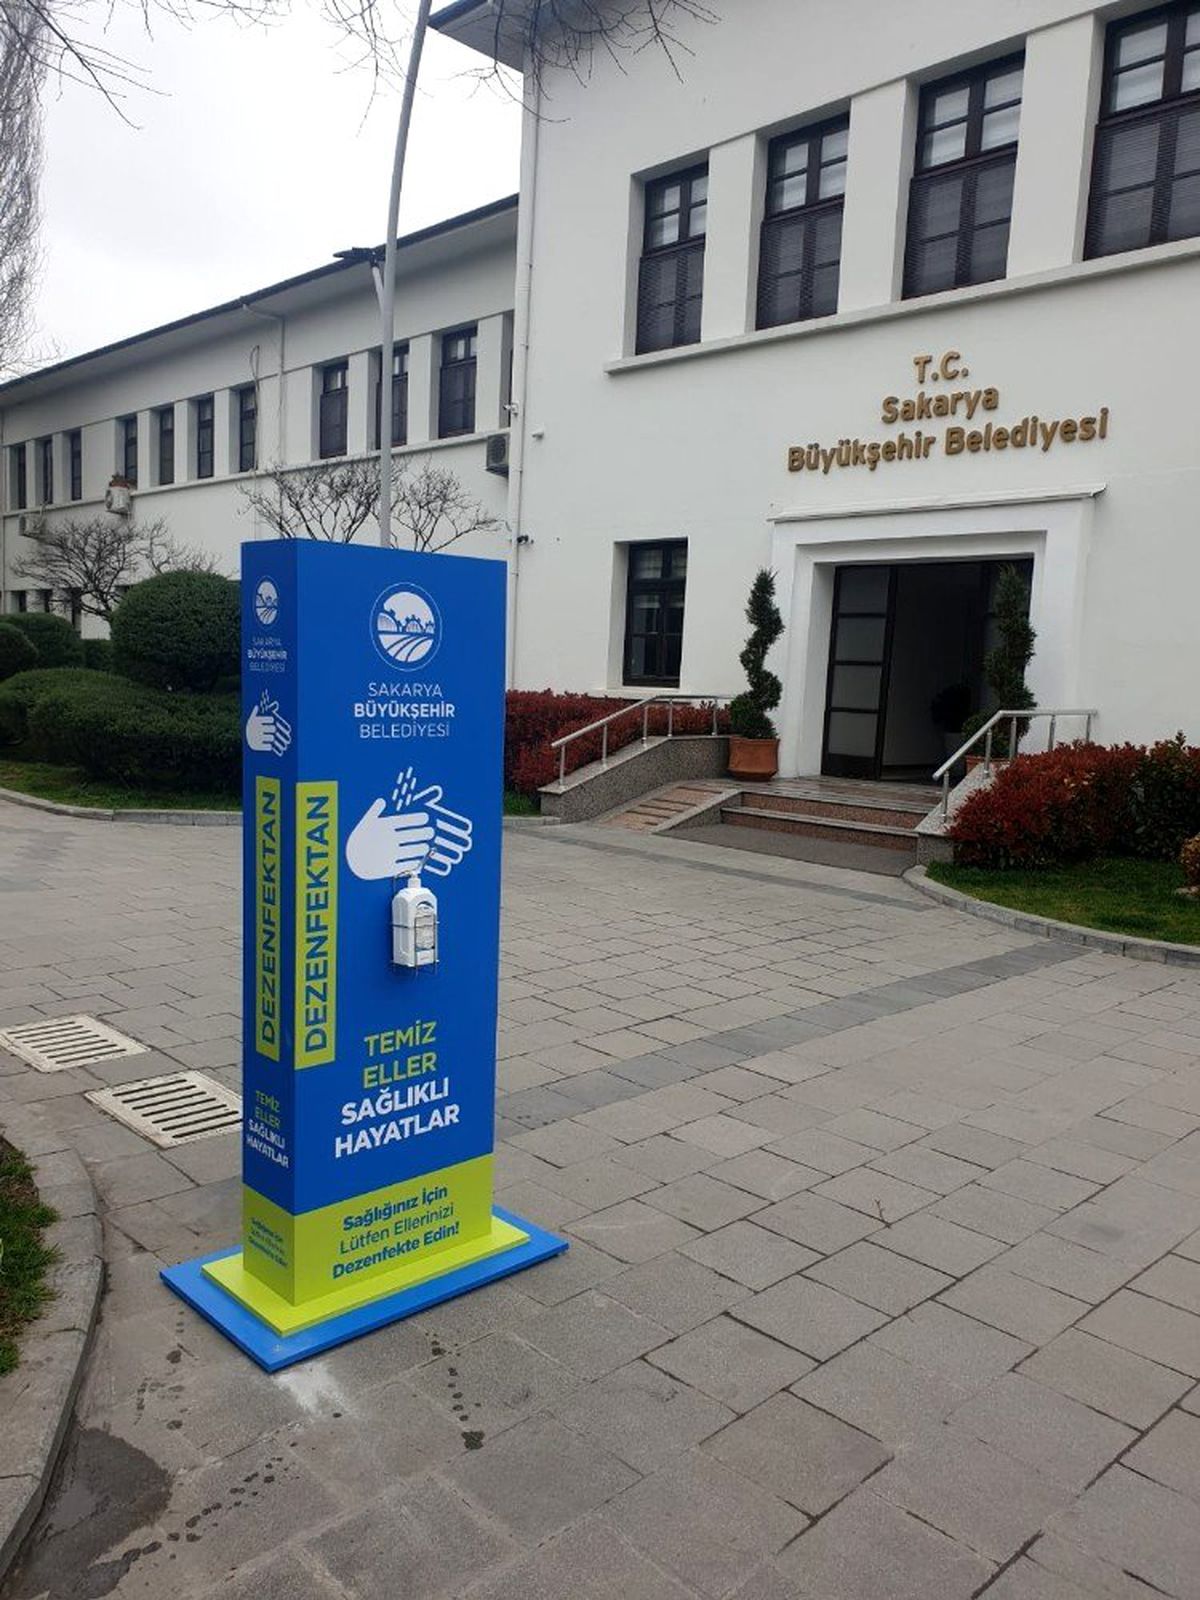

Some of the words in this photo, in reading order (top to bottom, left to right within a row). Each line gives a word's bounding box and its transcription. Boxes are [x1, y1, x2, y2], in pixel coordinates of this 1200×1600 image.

[913, 351, 969, 384] T.C.
[881, 386, 1000, 424] Sakarya
[787, 430, 936, 474] Büyükşehir
[944, 407, 1109, 456] Belediyesi
[368, 682, 443, 698] SAKARYA
[354, 700, 456, 721] BÜYÜKŞEHİR
[359, 720, 450, 739] BELEDİYESİ
[261, 791, 277, 1046] DEZENFEKTAN
[305, 795, 330, 1053] DEZENFEKTAN
[364, 1020, 437, 1056] TEMİZ
[363, 1052, 437, 1088] ELLER
[255, 1108, 281, 1130] ELLER
[256, 1090, 281, 1112] TEMİZ
[341, 1077, 450, 1125] SAĞLIKLI
[248, 1118, 286, 1149] SAĞLIKLI
[335, 1103, 460, 1158] HAYATLAR
[246, 1134, 289, 1168] HAYATLAR
[343, 1197, 418, 1231] Sağlığınız
[421, 1187, 448, 1205] İçin
[339, 1228, 390, 1254] Lütfen
[394, 1203, 454, 1235] Ellerinizi
[332, 1239, 419, 1279] Dezenfekte
[423, 1222, 460, 1246] Edin!
